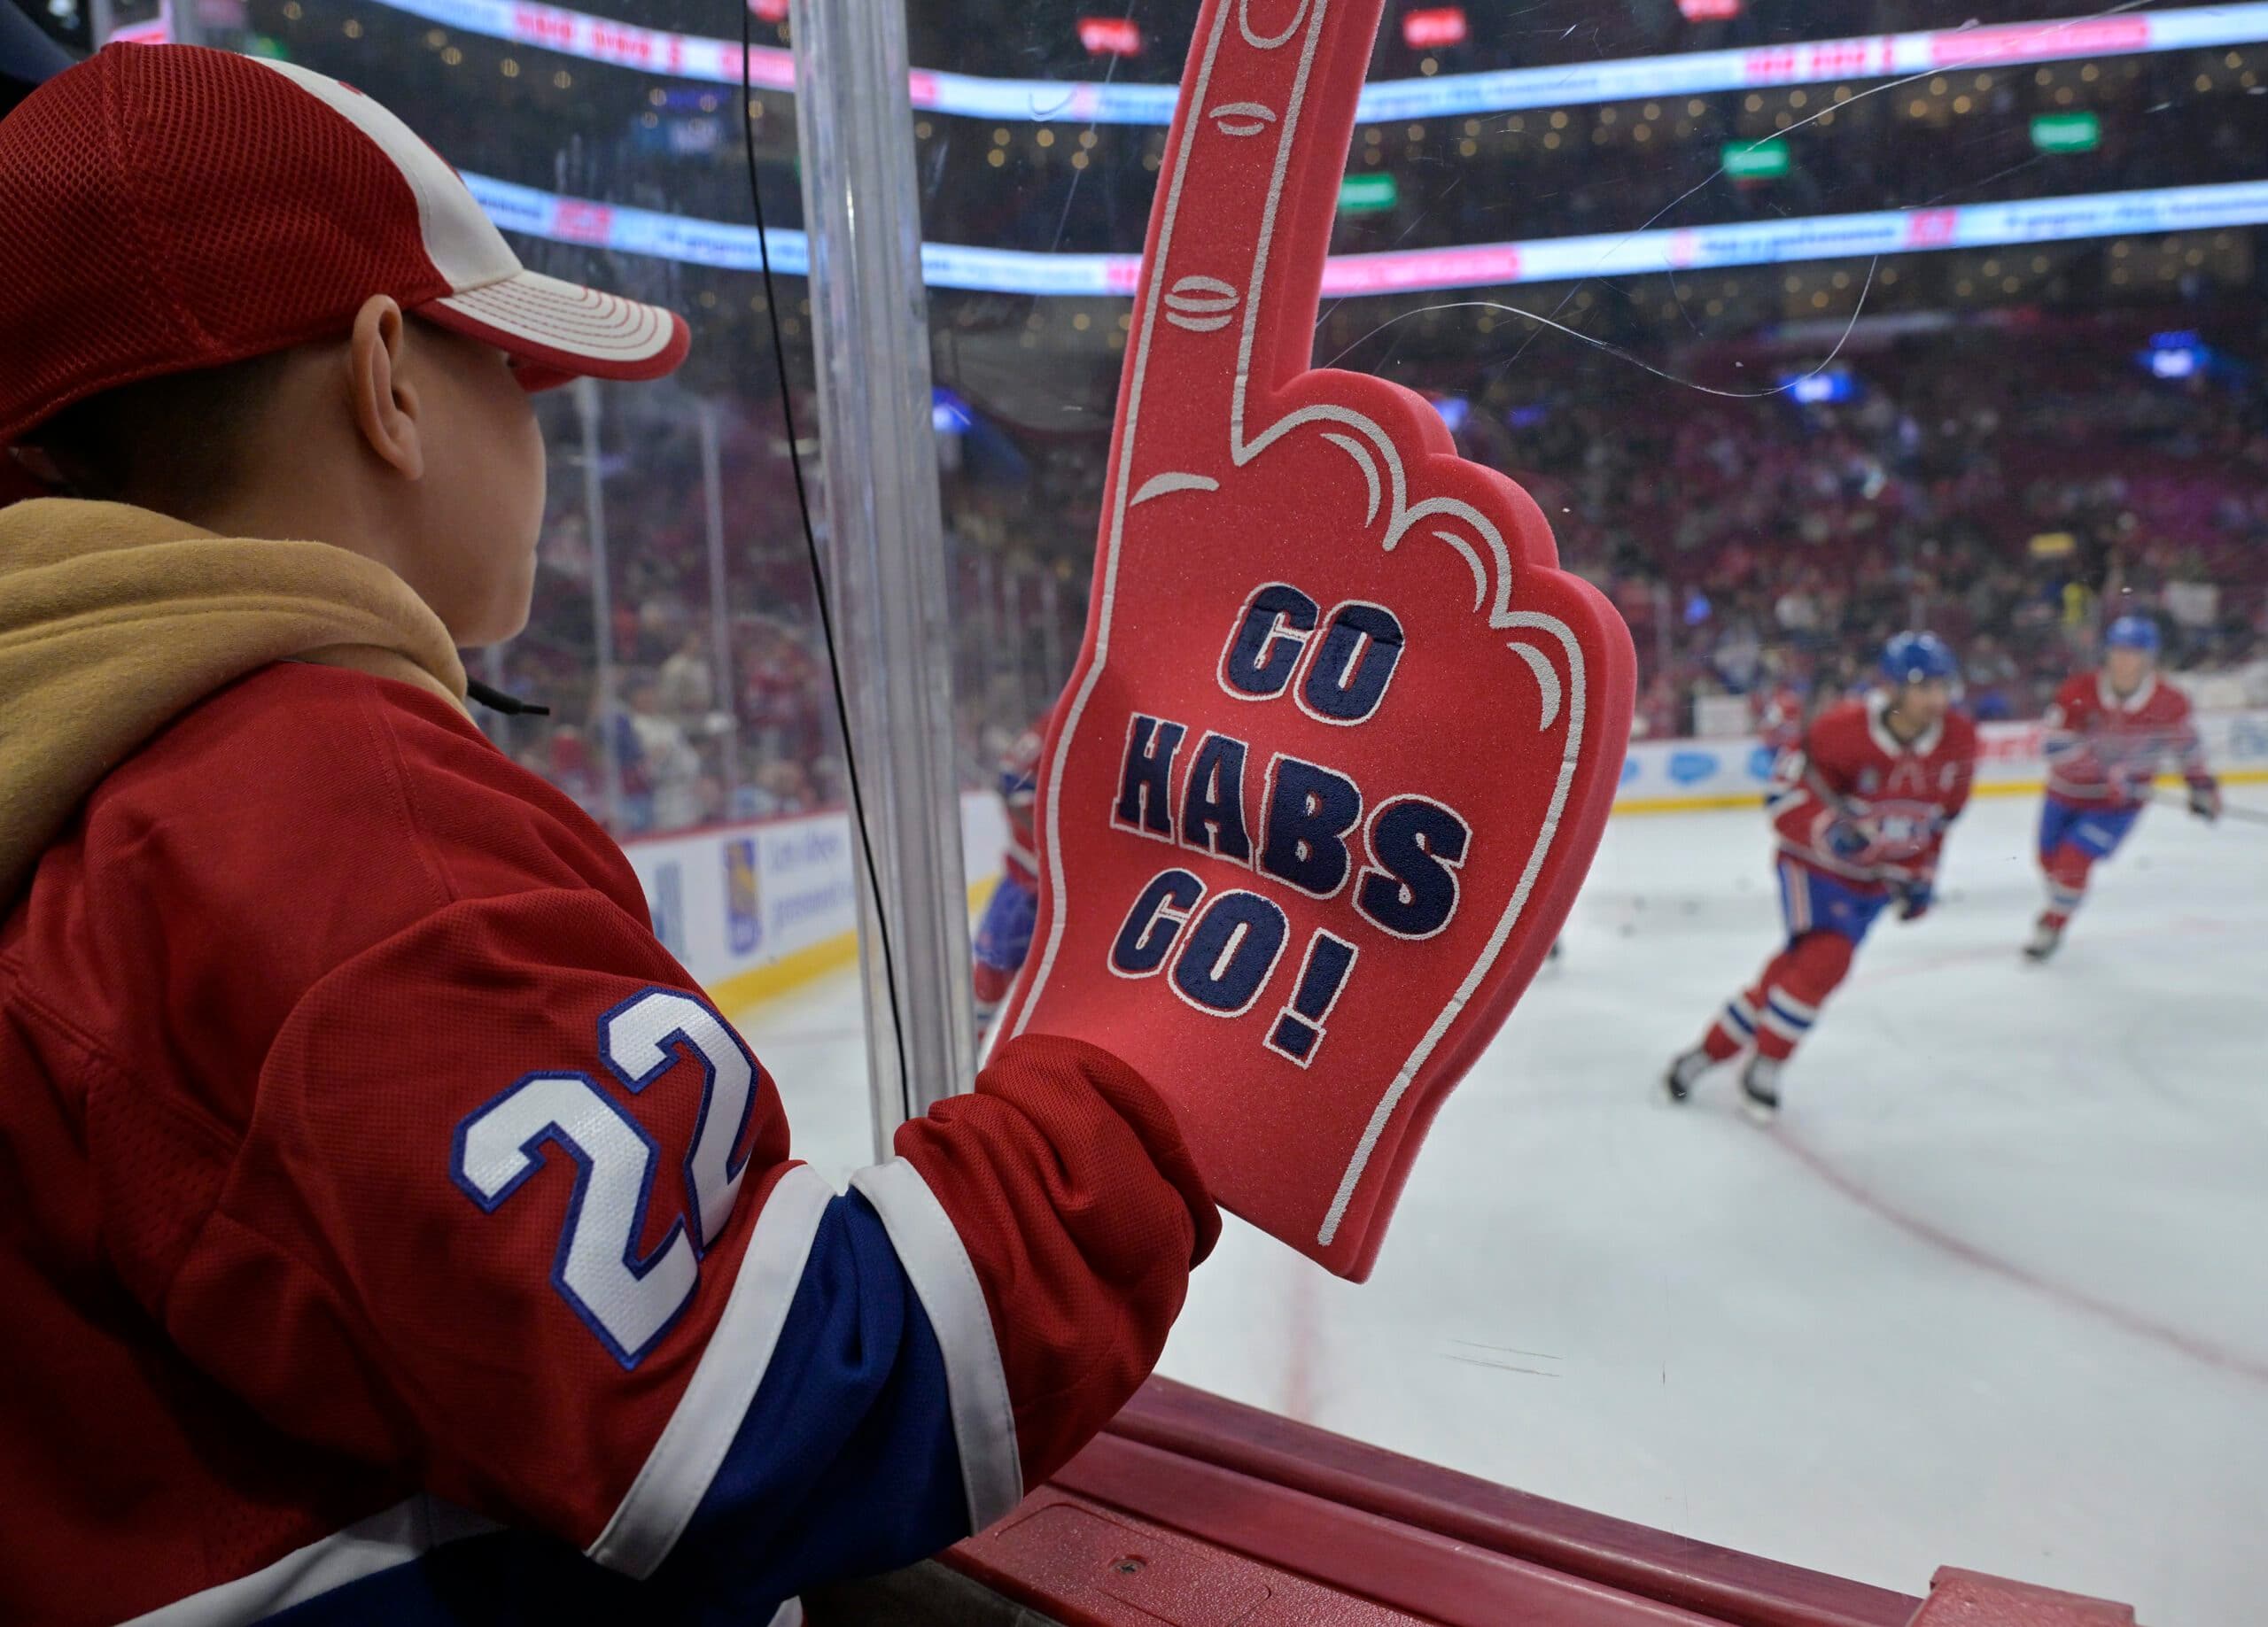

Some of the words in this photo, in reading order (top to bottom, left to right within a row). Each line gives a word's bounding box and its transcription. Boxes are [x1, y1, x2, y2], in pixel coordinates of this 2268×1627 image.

[1216, 581, 1406, 726] GO
[1109, 712, 1473, 940] HABS
[1107, 867, 1360, 1069] GO!
[449, 985, 759, 1371] 22
